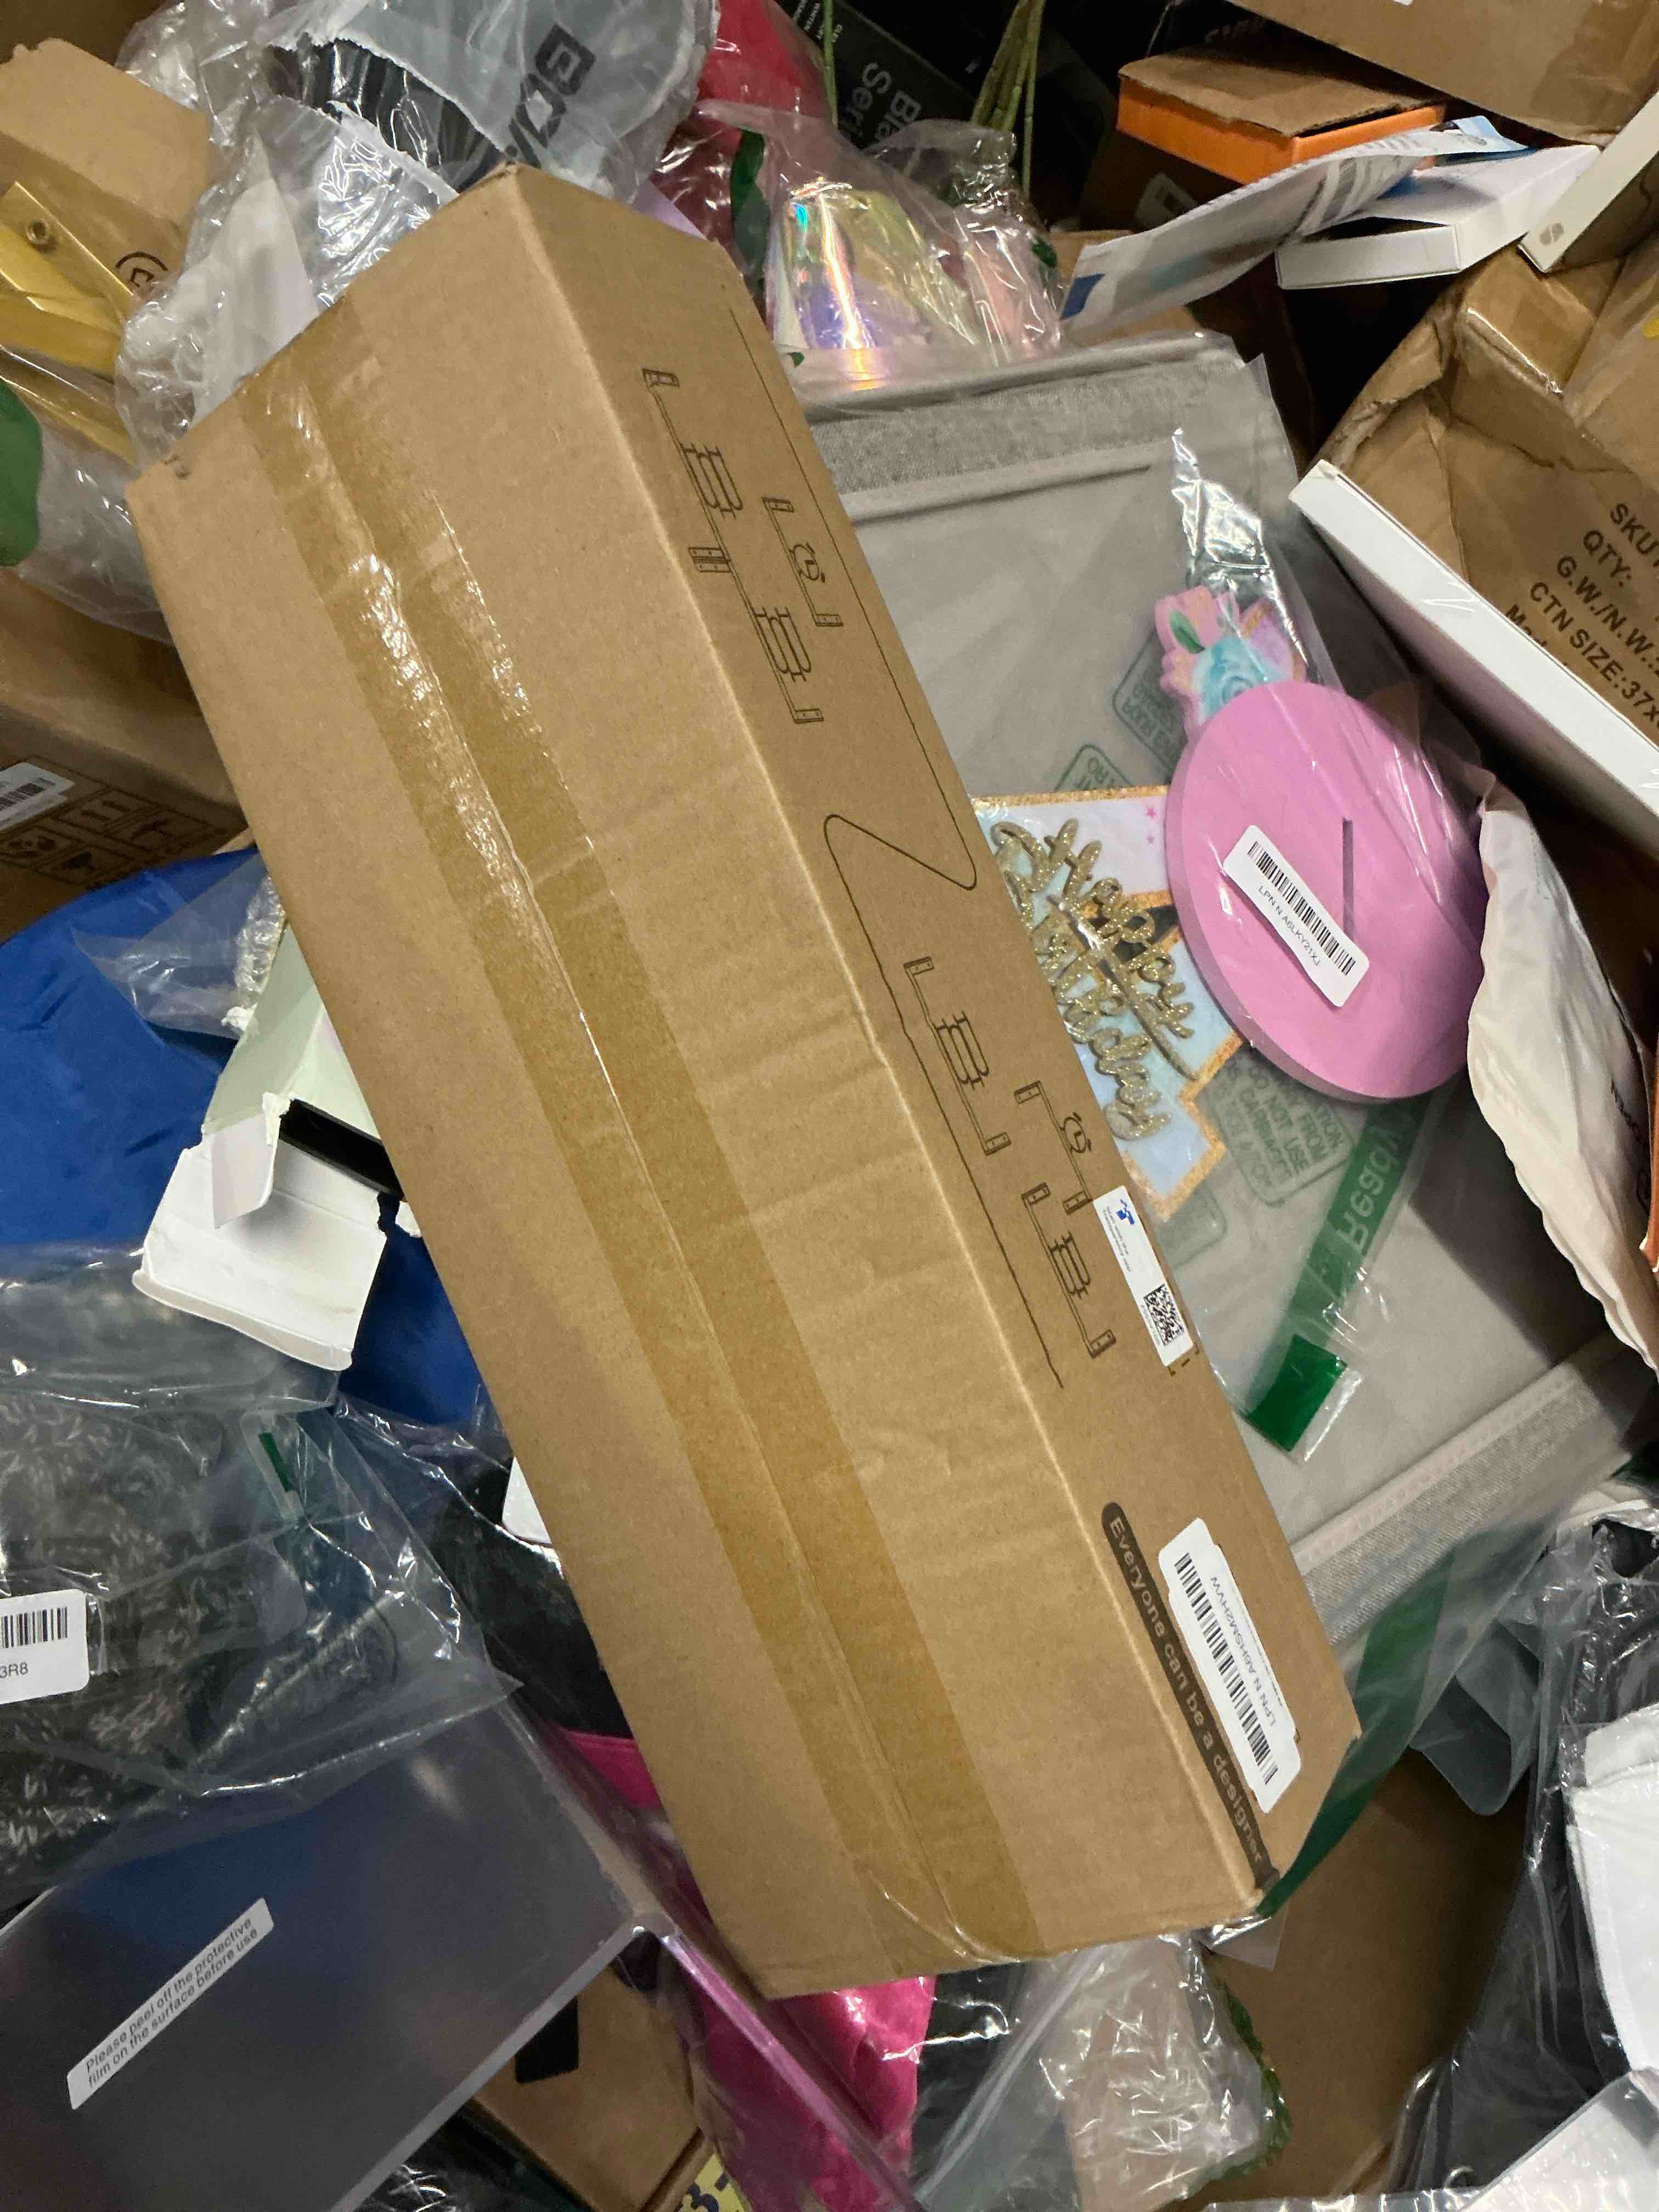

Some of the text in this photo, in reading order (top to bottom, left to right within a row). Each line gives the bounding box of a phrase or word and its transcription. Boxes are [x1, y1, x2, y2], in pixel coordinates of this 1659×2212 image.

[1610, 504, 1659, 555] SKU
[1583, 530, 1632, 587] QTY:
[1530, 582, 1659, 729] CTN SIZE:37x
[1259, 885, 1276, 906] LPN
[1276, 905, 1283, 916] N
[1109, 1516, 1262, 1863] Everyone can be a designer
[1254, 1677, 1262, 1691] N
[1259, 1694, 1276, 1727] LPN
[86, 1918, 252, 2073] Please peel off the protective
[88, 1928, 258, 2087] film on the surface before use
